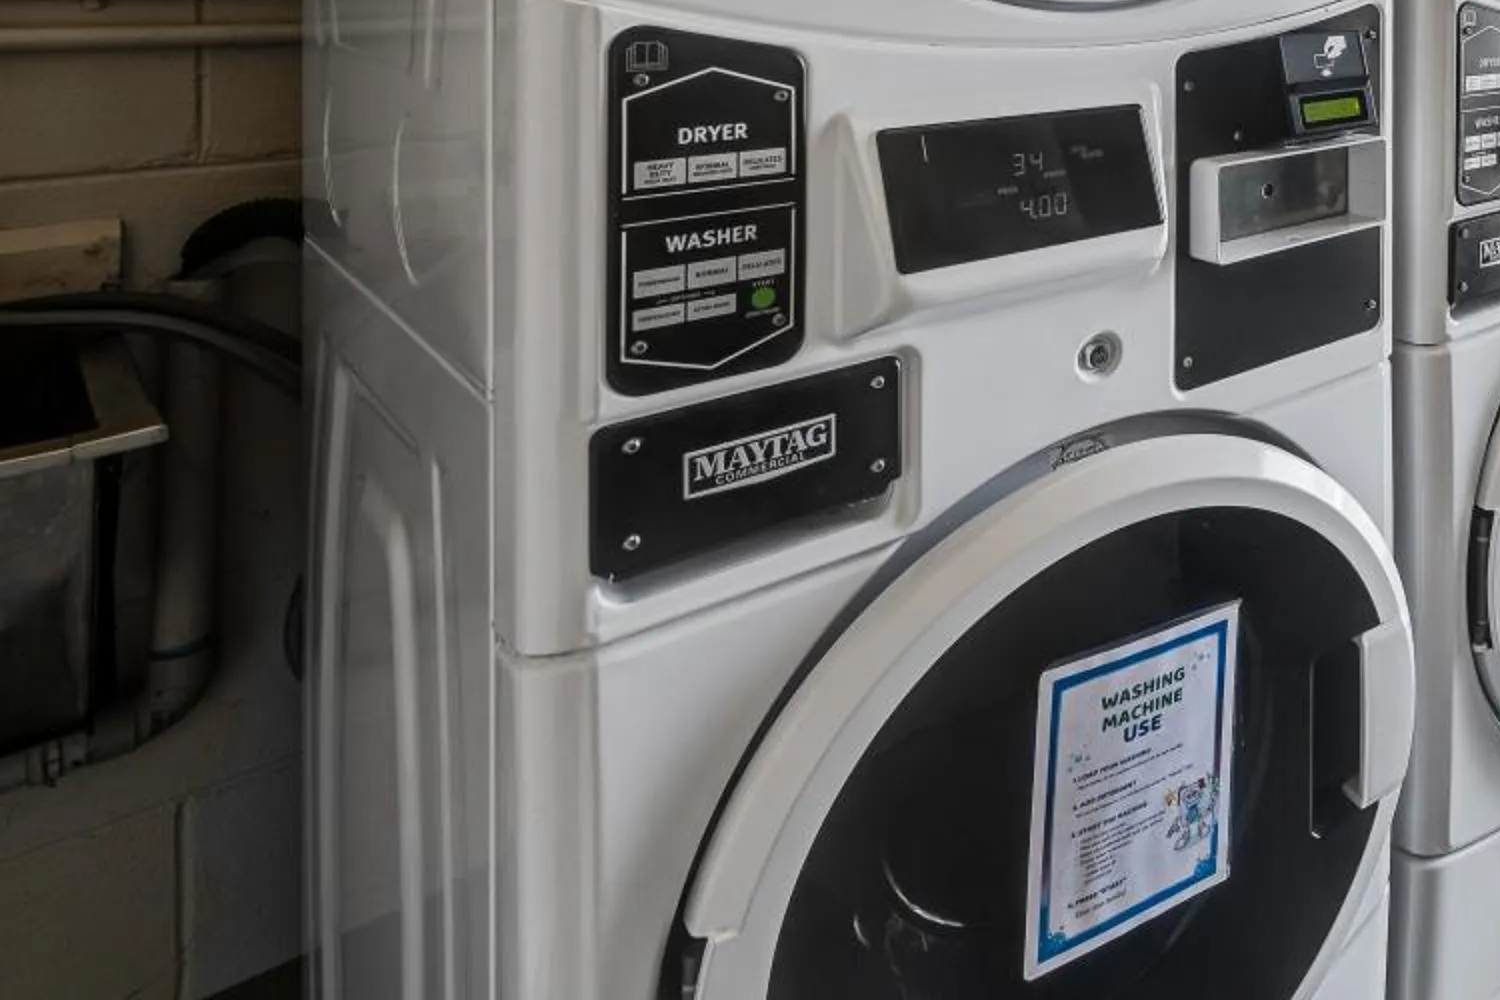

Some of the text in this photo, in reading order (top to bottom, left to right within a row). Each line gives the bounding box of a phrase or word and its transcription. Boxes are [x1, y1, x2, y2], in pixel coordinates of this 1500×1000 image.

[677, 122, 749, 145] DRYER
[665, 224, 759, 254] WASHER
[694, 422, 828, 482] MAYTAG
[715, 450, 805, 486] COMMERCIAL
[1101, 665, 1186, 711] WASHING
[1101, 686, 1184, 735] MACHINE
[1123, 712, 1163, 743] USE
